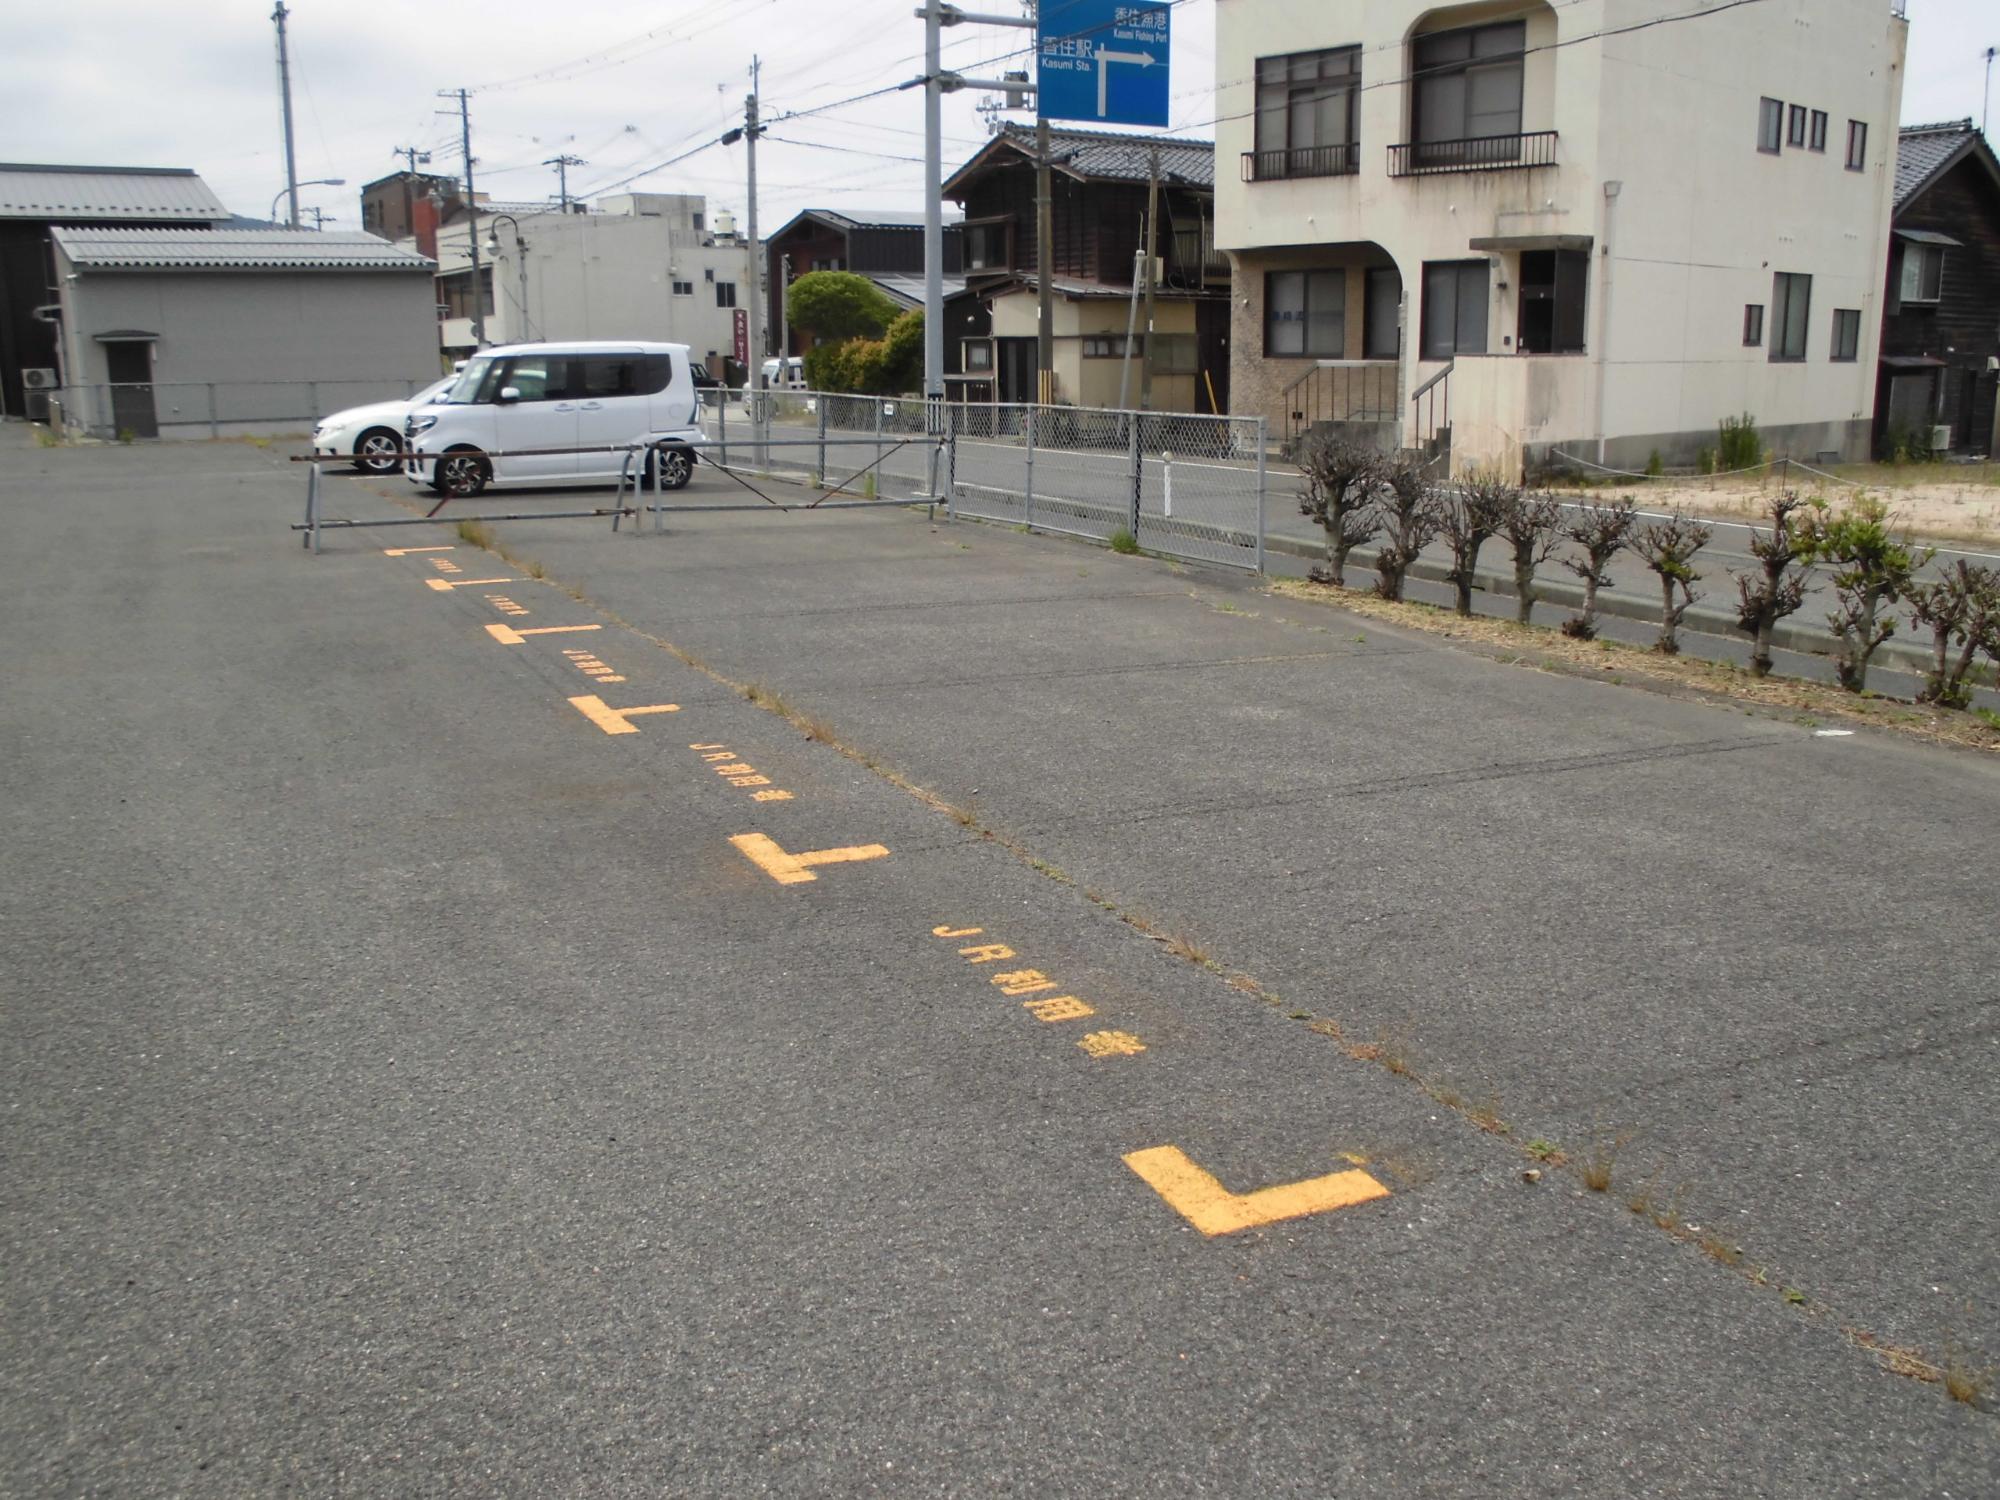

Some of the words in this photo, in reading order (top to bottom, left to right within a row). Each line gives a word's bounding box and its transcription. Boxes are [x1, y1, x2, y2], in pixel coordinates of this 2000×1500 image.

[1114, 7, 1167, 30] 香住漁港
[1113, 28, 1134, 40] Kasumi
[1135, 31, 1154, 44] Fishing
[1155, 32, 1168, 42] Port
[1043, 36, 1094, 58] 香住駅
[1042, 58, 1073, 70] Kasumi
[1076, 59, 1092, 72] Sta.
